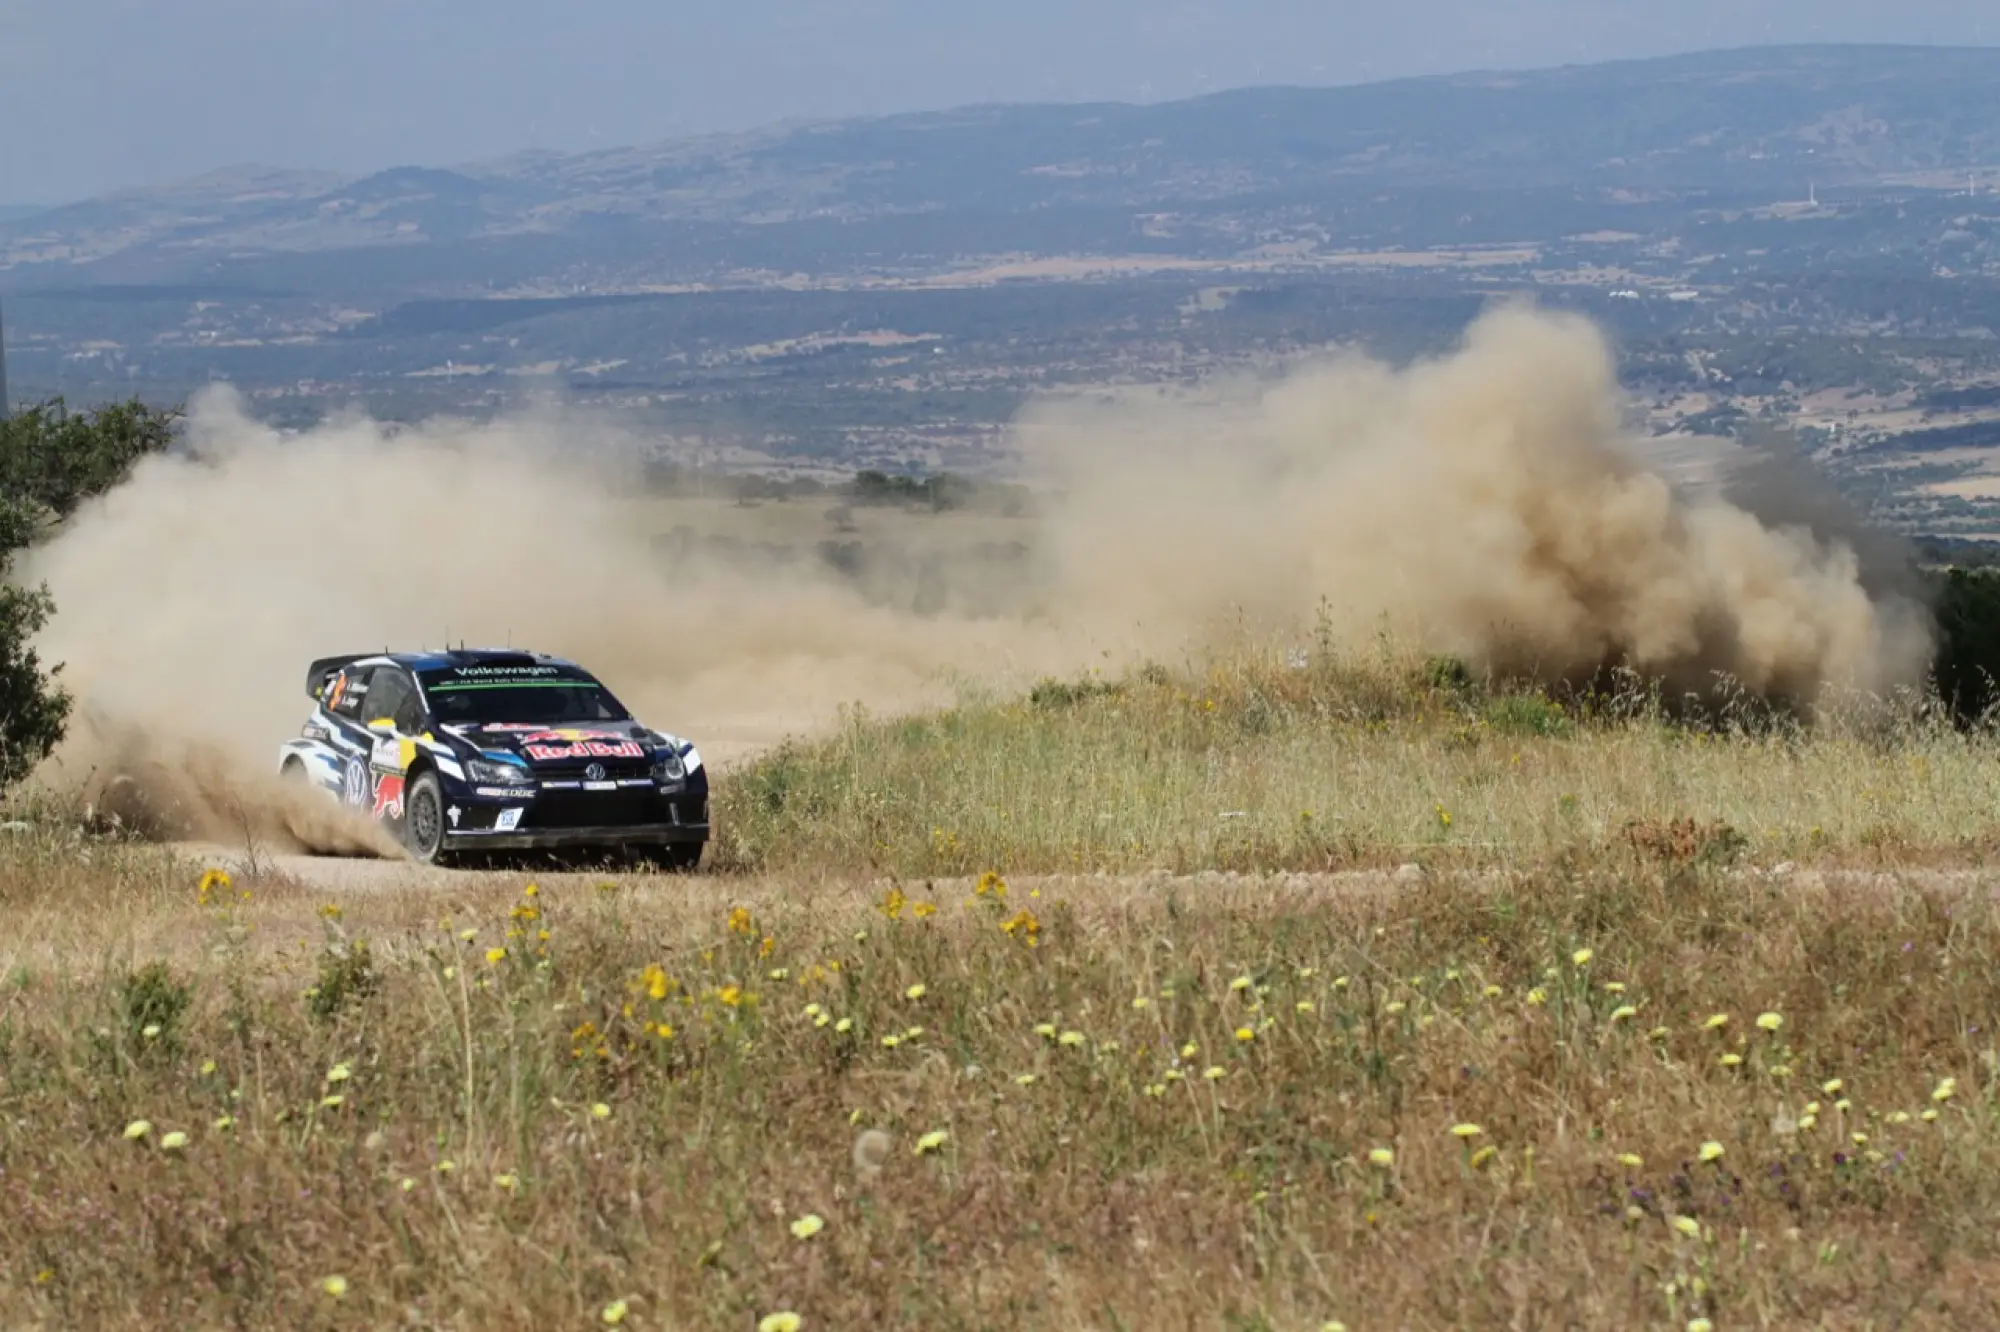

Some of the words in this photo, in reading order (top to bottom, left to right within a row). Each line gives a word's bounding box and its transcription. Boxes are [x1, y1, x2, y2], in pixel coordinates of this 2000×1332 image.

[454, 666, 559, 676] Volkswagen
[527, 741, 590, 760] Red
[585, 741, 644, 757] Bull
